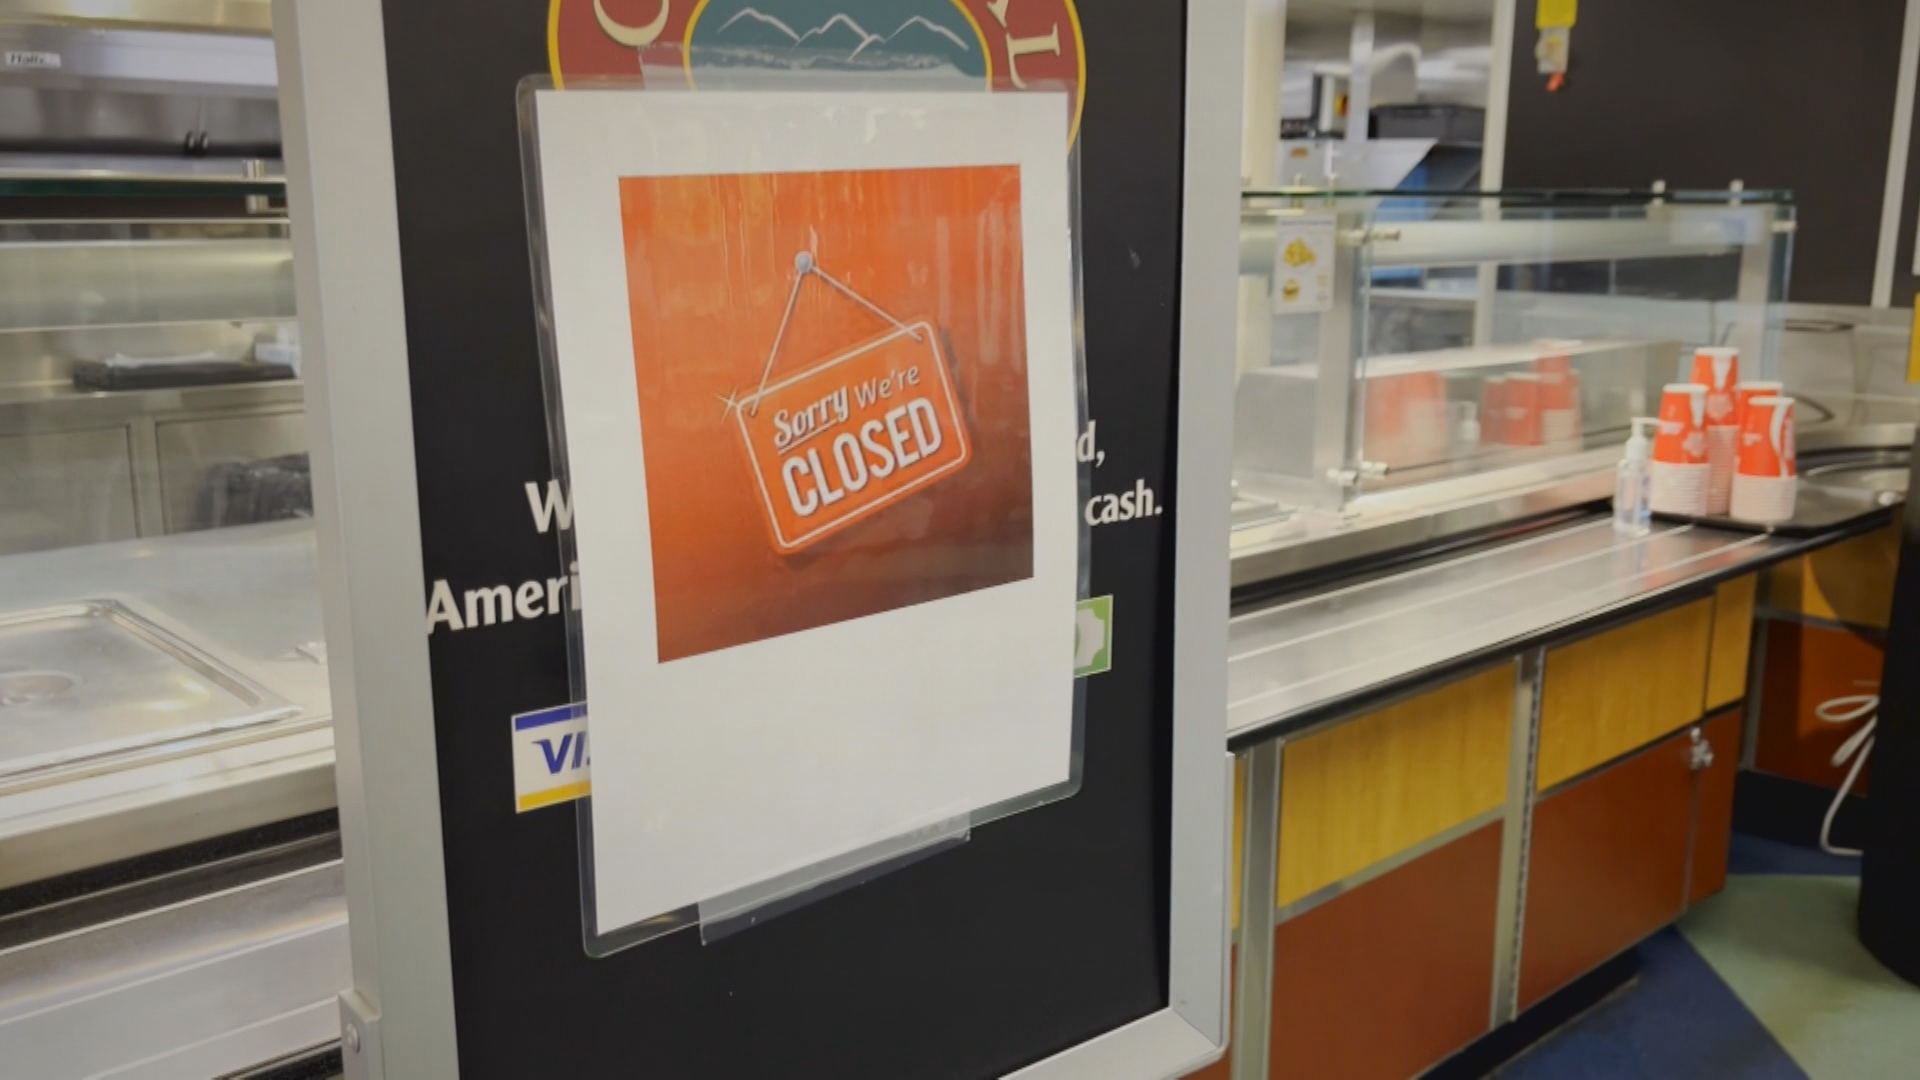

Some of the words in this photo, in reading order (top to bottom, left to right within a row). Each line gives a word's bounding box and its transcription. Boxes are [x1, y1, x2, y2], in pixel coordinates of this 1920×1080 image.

[774, 385, 849, 448] Sorry
[854, 366, 921, 409] We're
[782, 398, 942, 517] CLOSED
[427, 561, 582, 635] Ameri
[1085, 478, 1163, 526] cash.
[531, 731, 590, 775] VI
